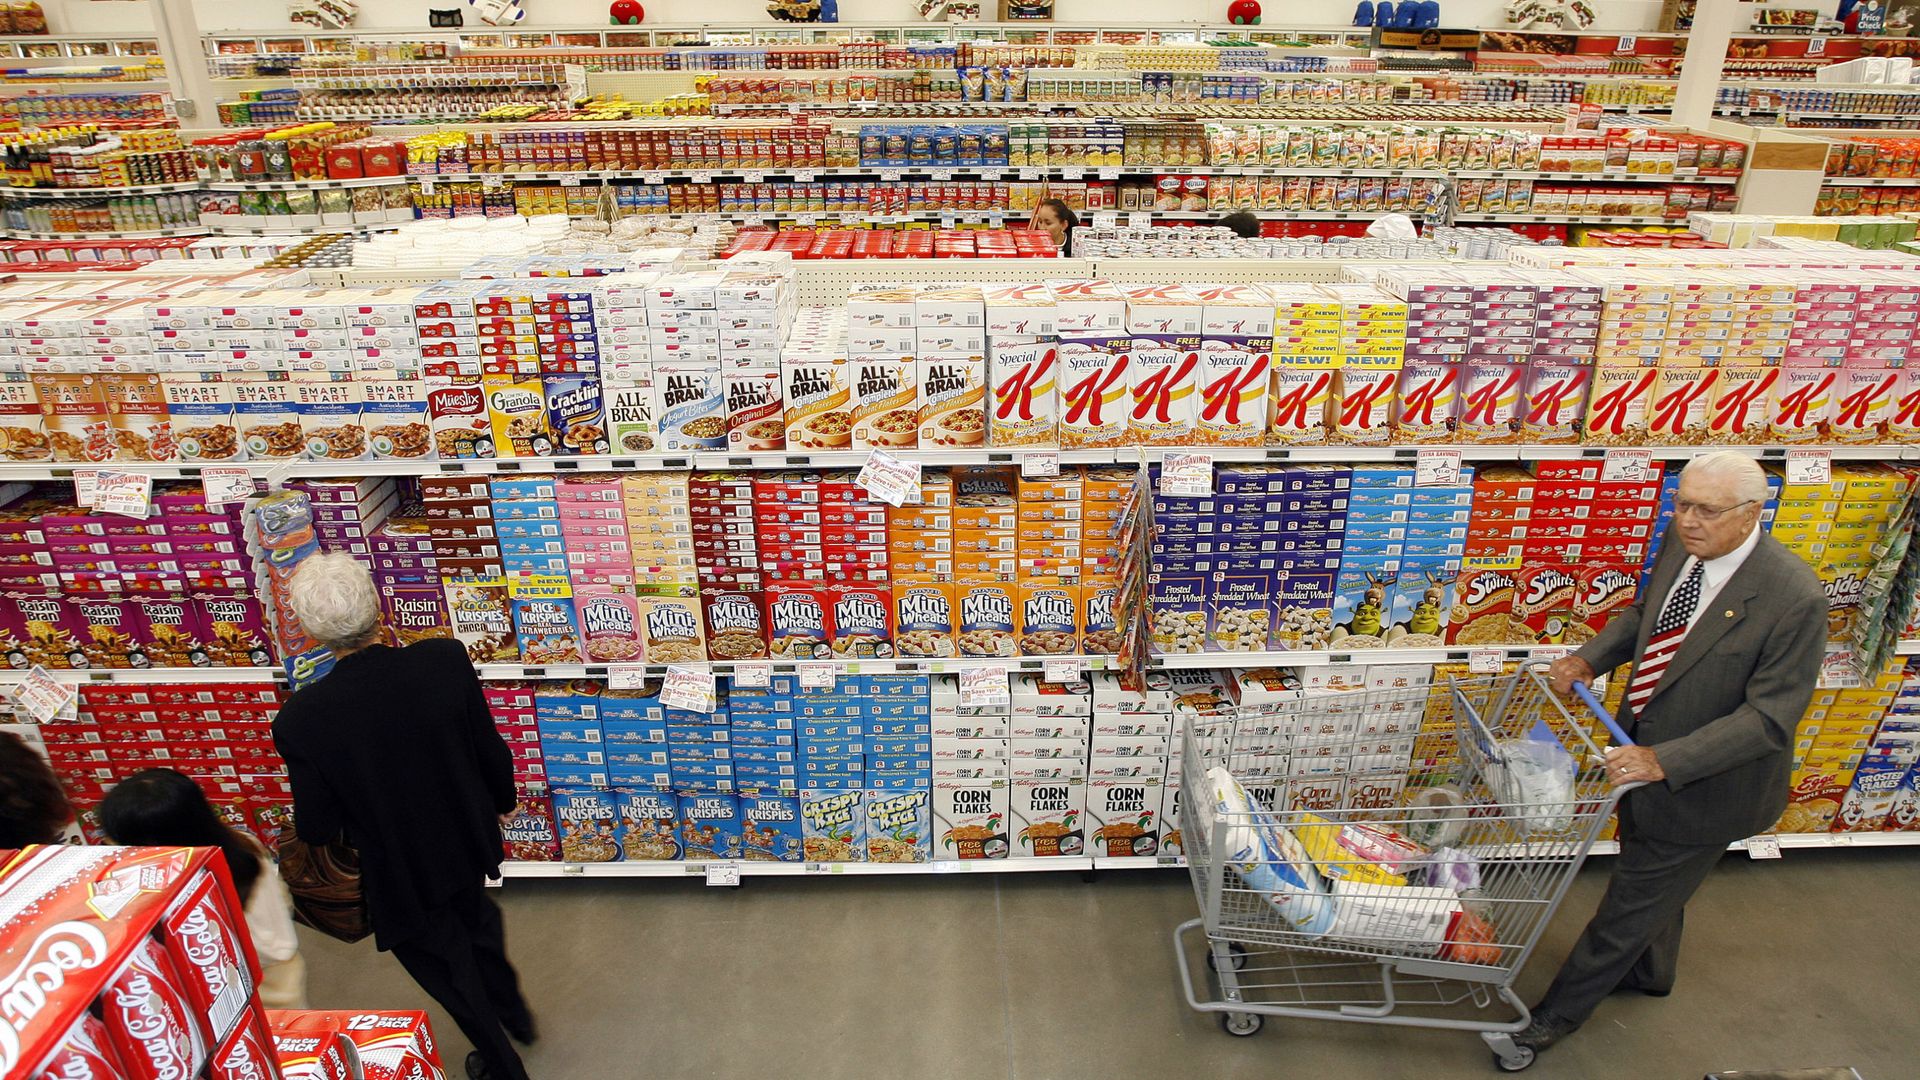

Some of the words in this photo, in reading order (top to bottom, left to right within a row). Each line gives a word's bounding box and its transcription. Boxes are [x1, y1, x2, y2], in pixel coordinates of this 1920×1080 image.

[1106, 340, 1132, 348] FREE
[1175, 337, 1200, 345] FREE
[1246, 338, 1272, 346] FREE
[998, 350, 1038, 367] Special
[1068, 356, 1108, 372] Special
[1136, 352, 1178, 368] Special
[1207, 353, 1248, 369] Special
[1280, 356, 1331, 364] NEW!
[1346, 356, 1396, 364] NEW!
[170, 386, 218, 395] SMART
[236, 386, 286, 394] SMART
[299, 386, 349, 395] SMART
[366, 386, 414, 394] SMART
[667, 376, 701, 392] ALL-
[730, 382, 762, 398] ALL-
[790, 381, 830, 400] BRAN
[858, 379, 896, 398] BRAN
[925, 378, 965, 397] BRAN
[996, 348, 1056, 420] K
[1064, 354, 1130, 426] K
[1132, 352, 1198, 422] K
[1201, 354, 1269, 424] K
[172, 394, 220, 402] START
[301, 394, 350, 402] START
[434, 391, 480, 408] Müeslix
[491, 392, 541, 411] Granola
[550, 382, 600, 412] Cracklin'
[615, 392, 648, 407] ALL-
[664, 388, 704, 408] BRAN
[727, 394, 766, 413] BRAN
[1276, 372, 1330, 428] K
[560, 406, 574, 418] Oat
[574, 402, 592, 414] Bran
[611, 406, 652, 423] BRAN
[661, 409, 689, 428] Yogurt
[688, 402, 709, 417] Bites
[730, 408, 765, 426] Original
[516, 586, 562, 595] NEW!
[1165, 585, 1192, 594] Frosted
[1229, 582, 1256, 592] Frosted
[1293, 582, 1320, 591] Frosted
[1466, 574, 1515, 605] Swirlz
[1526, 572, 1576, 605] Swirlz
[1587, 572, 1636, 604] Swirlz
[1820, 573, 1866, 598] olde
[1148, 593, 1181, 604] Shredded
[1182, 593, 1206, 602] Wheat
[1212, 592, 1244, 602] Shredded
[1246, 592, 1270, 601] Wheat
[1276, 590, 1308, 600] Shredded
[1308, 590, 1333, 600] Wheat
[1526, 596, 1559, 614] Cinnamon
[1558, 590, 1574, 600] Bun
[1587, 596, 1620, 614] Cinnamon
[1621, 590, 1635, 600] Bun
[18, 600, 61, 614] Raisin
[80, 604, 122, 617] Raisin
[142, 604, 184, 616] Raisin
[206, 601, 246, 614] Raisin
[462, 600, 496, 611] COCOA
[584, 602, 632, 620] Mini-
[709, 600, 760, 620] Mini-
[26, 611, 60, 622] Bran
[88, 614, 120, 626] Bran
[150, 614, 182, 626] Bran
[214, 612, 245, 623] Bran
[400, 612, 436, 627] Bran
[458, 610, 504, 624] KRISPIES
[520, 612, 568, 624] KRISPIES
[648, 610, 696, 628] Mini-
[712, 616, 758, 630] Wheats
[774, 615, 822, 631] Wheats
[902, 612, 948, 627] Wheats
[518, 626, 575, 634] STRAWBERRIES
[586, 618, 632, 632] Wheats
[650, 625, 696, 638] Wheats
[1797, 774, 1839, 791] Eggo
[1858, 772, 1904, 784] FROSTED
[1300, 786, 1331, 798] Corn
[1360, 784, 1392, 798] Corn
[1860, 780, 1900, 792] FLAKES
[953, 790, 991, 804] CORN
[1031, 787, 1069, 800] CORN
[1106, 788, 1145, 800] CORN
[570, 797, 598, 809] RICE
[632, 796, 659, 808] RICE
[697, 799, 720, 809] RICE
[758, 800, 781, 810] RICE
[802, 790, 863, 818] CRISPY
[866, 791, 927, 818] CRISPY
[953, 804, 992, 814] FLAKES
[1030, 800, 1069, 811] FLAKES
[1106, 800, 1144, 812] FLAKES
[1350, 796, 1394, 810] Flakes
[558, 806, 614, 820] KRISPIES
[620, 806, 674, 820] KRISPIES
[686, 808, 734, 820] KRISPIES
[746, 810, 794, 822] KRISPIES
[815, 809, 850, 832] RICE
[504, 830, 552, 842] KRISPIES
[1034, 838, 1056, 848] Free
[958, 839, 982, 850] Free
[1108, 838, 1131, 849] Free
[347, 1014, 380, 1030] 12
[376, 1020, 410, 1028] PACK
[277, 1043, 316, 1052] PACK
